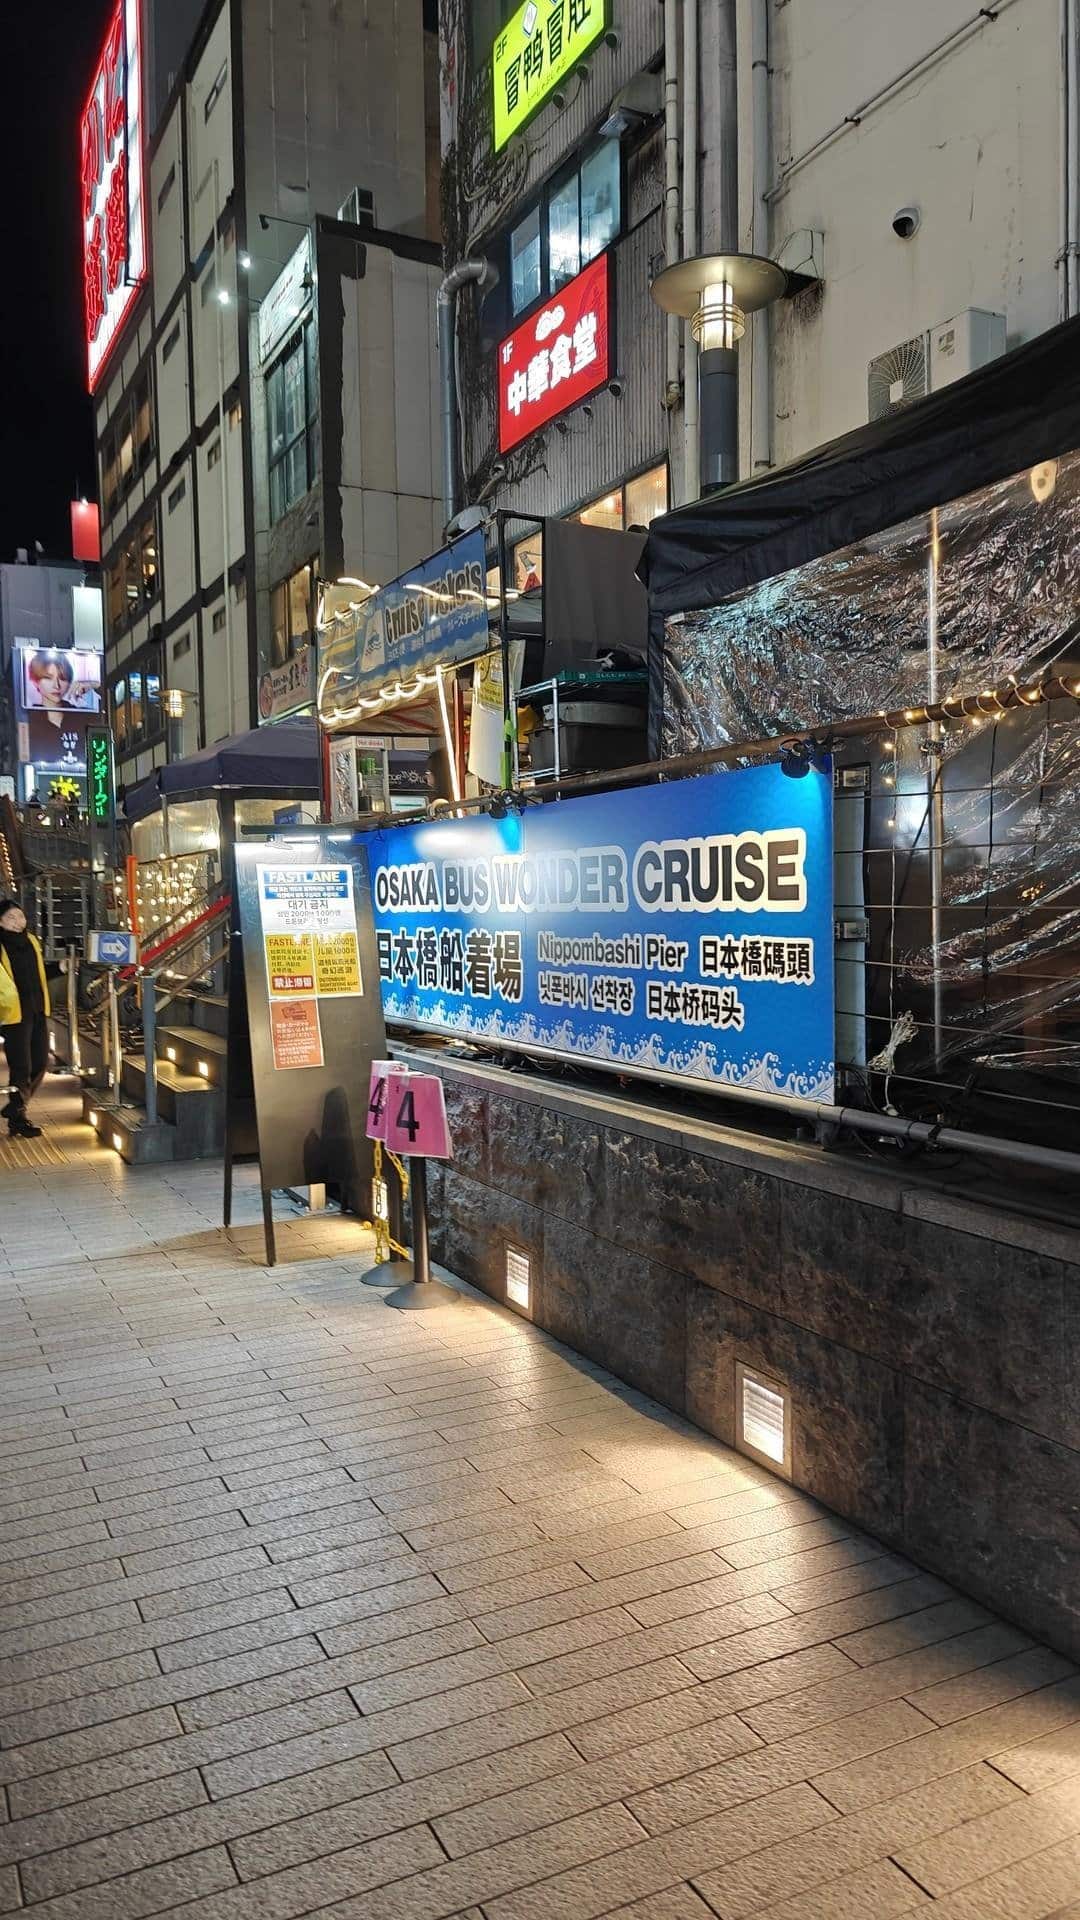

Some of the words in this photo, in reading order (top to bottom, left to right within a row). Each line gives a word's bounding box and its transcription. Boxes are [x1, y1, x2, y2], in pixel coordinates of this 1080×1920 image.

[496, 34, 508, 63] 2F
[502, 340, 514, 365] 1F
[507, 312, 598, 416] 中華食堂
[385, 595, 426, 646] Cruise
[269, 871, 341, 883] FASTLANE
[376, 867, 440, 907] OSAKA
[444, 864, 489, 907] BUS
[495, 854, 624, 906] WONDER
[637, 840, 800, 904] CRUISE
[288, 899, 307, 910] 대기
[310, 899, 329, 910] 금지
[376, 930, 522, 999] 日本橋船着場
[539, 934, 640, 966] Nippombashi
[647, 937, 687, 968] Pier
[702, 939, 811, 979] 日本橋碼頭
[540, 975, 587, 1006] 닛폰바시
[592, 979, 633, 1011] 선착장
[648, 985, 742, 1026] 日本桥码头
[396, 1091, 420, 1142] 4
